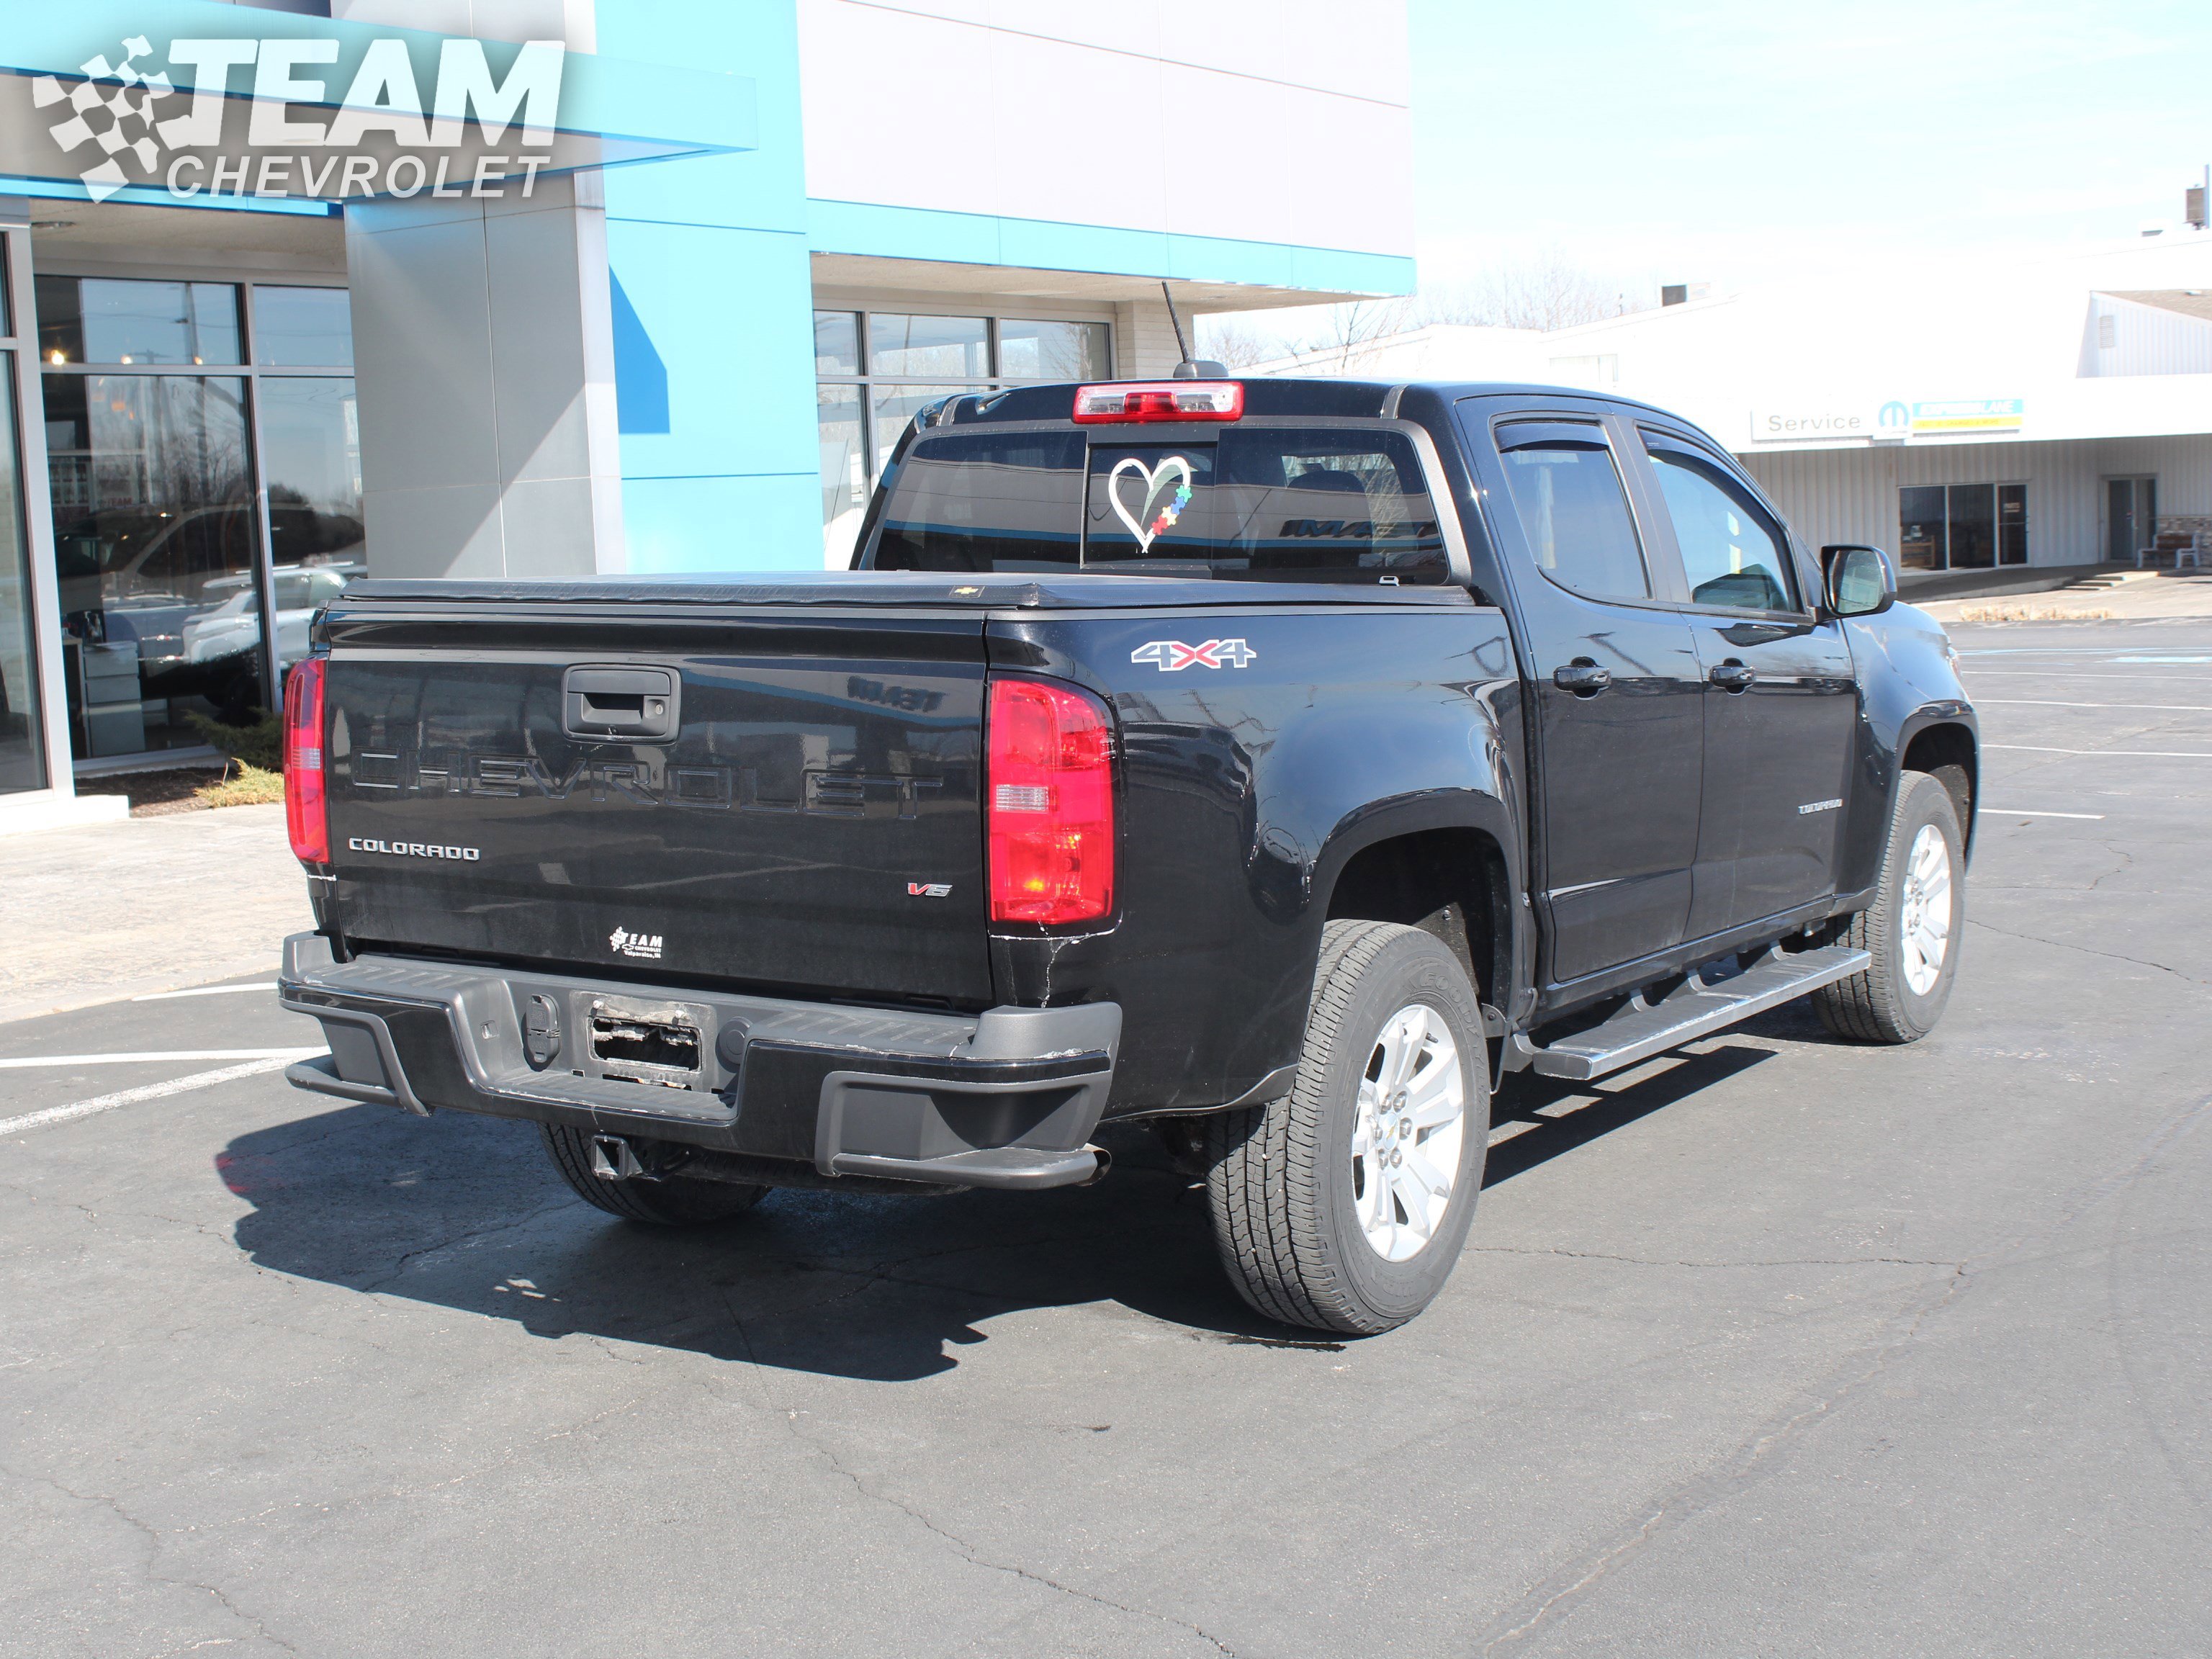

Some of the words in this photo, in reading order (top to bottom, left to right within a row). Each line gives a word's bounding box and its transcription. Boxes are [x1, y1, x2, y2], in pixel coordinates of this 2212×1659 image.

[1768, 414, 1861, 432] Service
[351, 746, 944, 819] CHEVROLET
[349, 837, 480, 860] COLORADO
[907, 883, 953, 896] V6
[621, 932, 662, 948] TEAM
